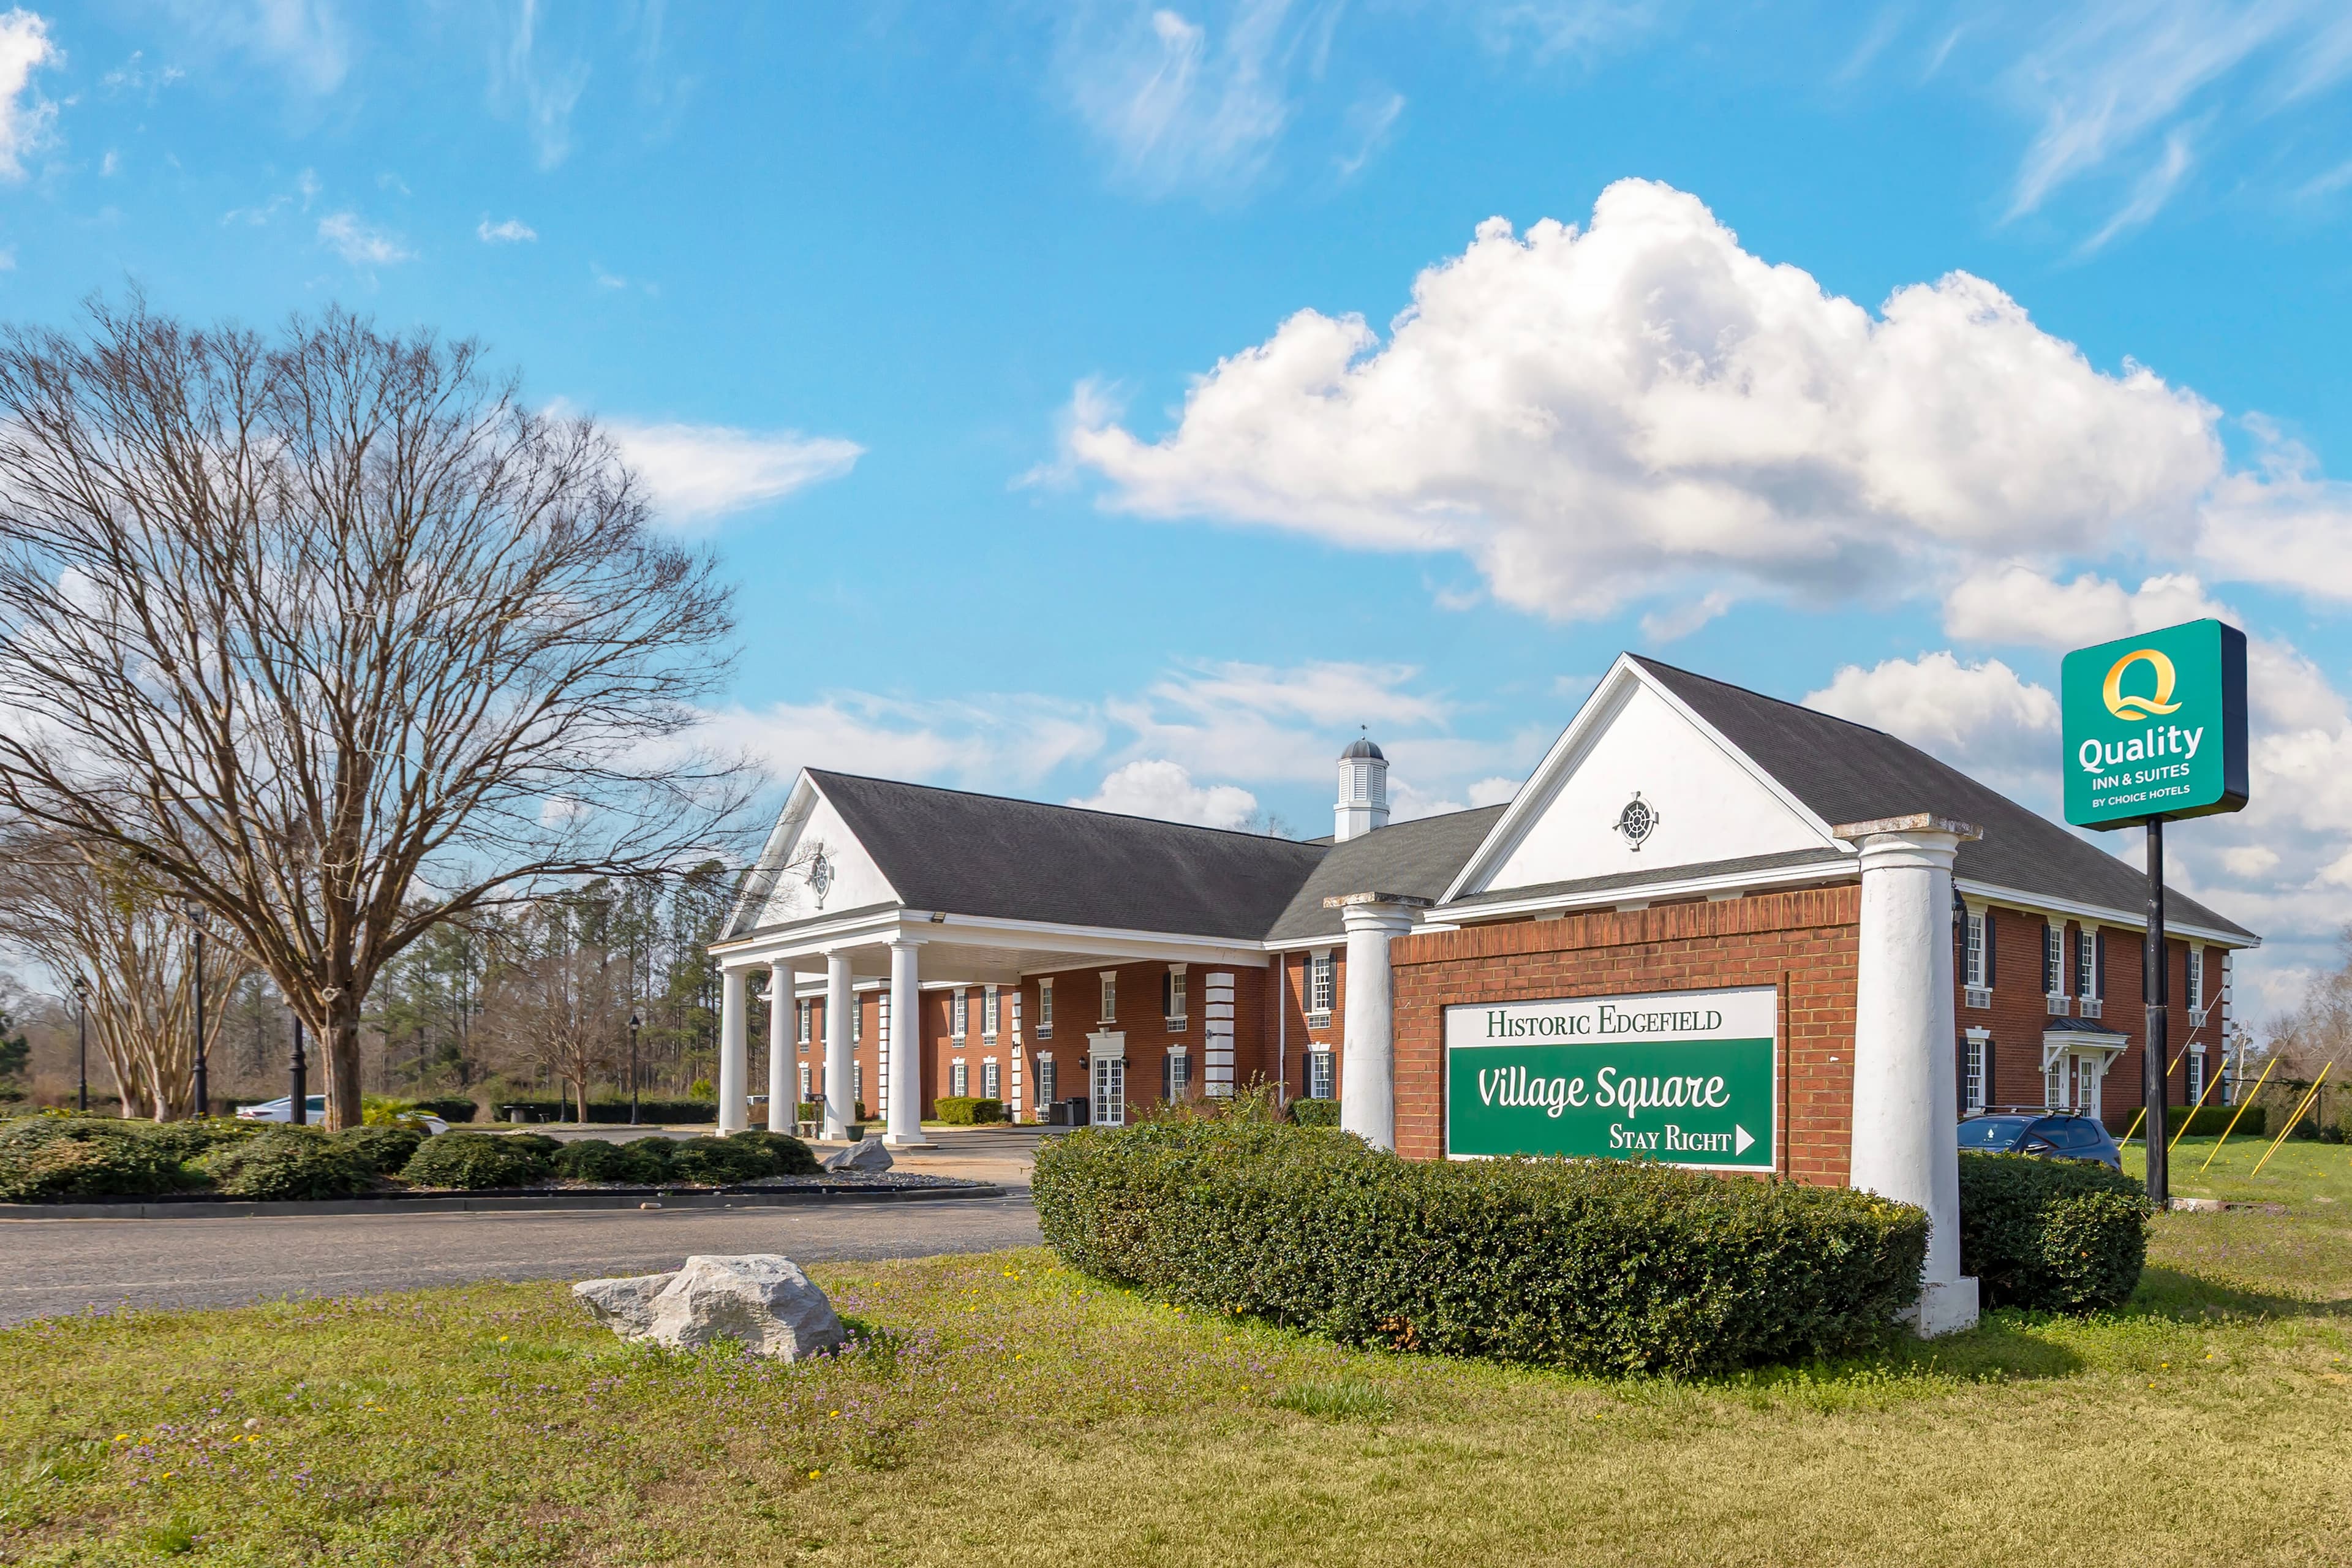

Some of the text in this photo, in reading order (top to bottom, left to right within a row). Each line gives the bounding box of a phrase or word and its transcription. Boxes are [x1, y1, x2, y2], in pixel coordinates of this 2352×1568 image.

[2079, 725, 2204, 774] Quality
[2092, 763, 2190, 790] INN & SUITES
[2092, 785, 2190, 808] BY CHOICE HOTELS
[1486, 1005, 1722, 1038] HISTORIC EDGEFIELD
[1479, 1066, 1731, 1119] Village Square
[1610, 1123, 1732, 1152] STAY RIGHT
